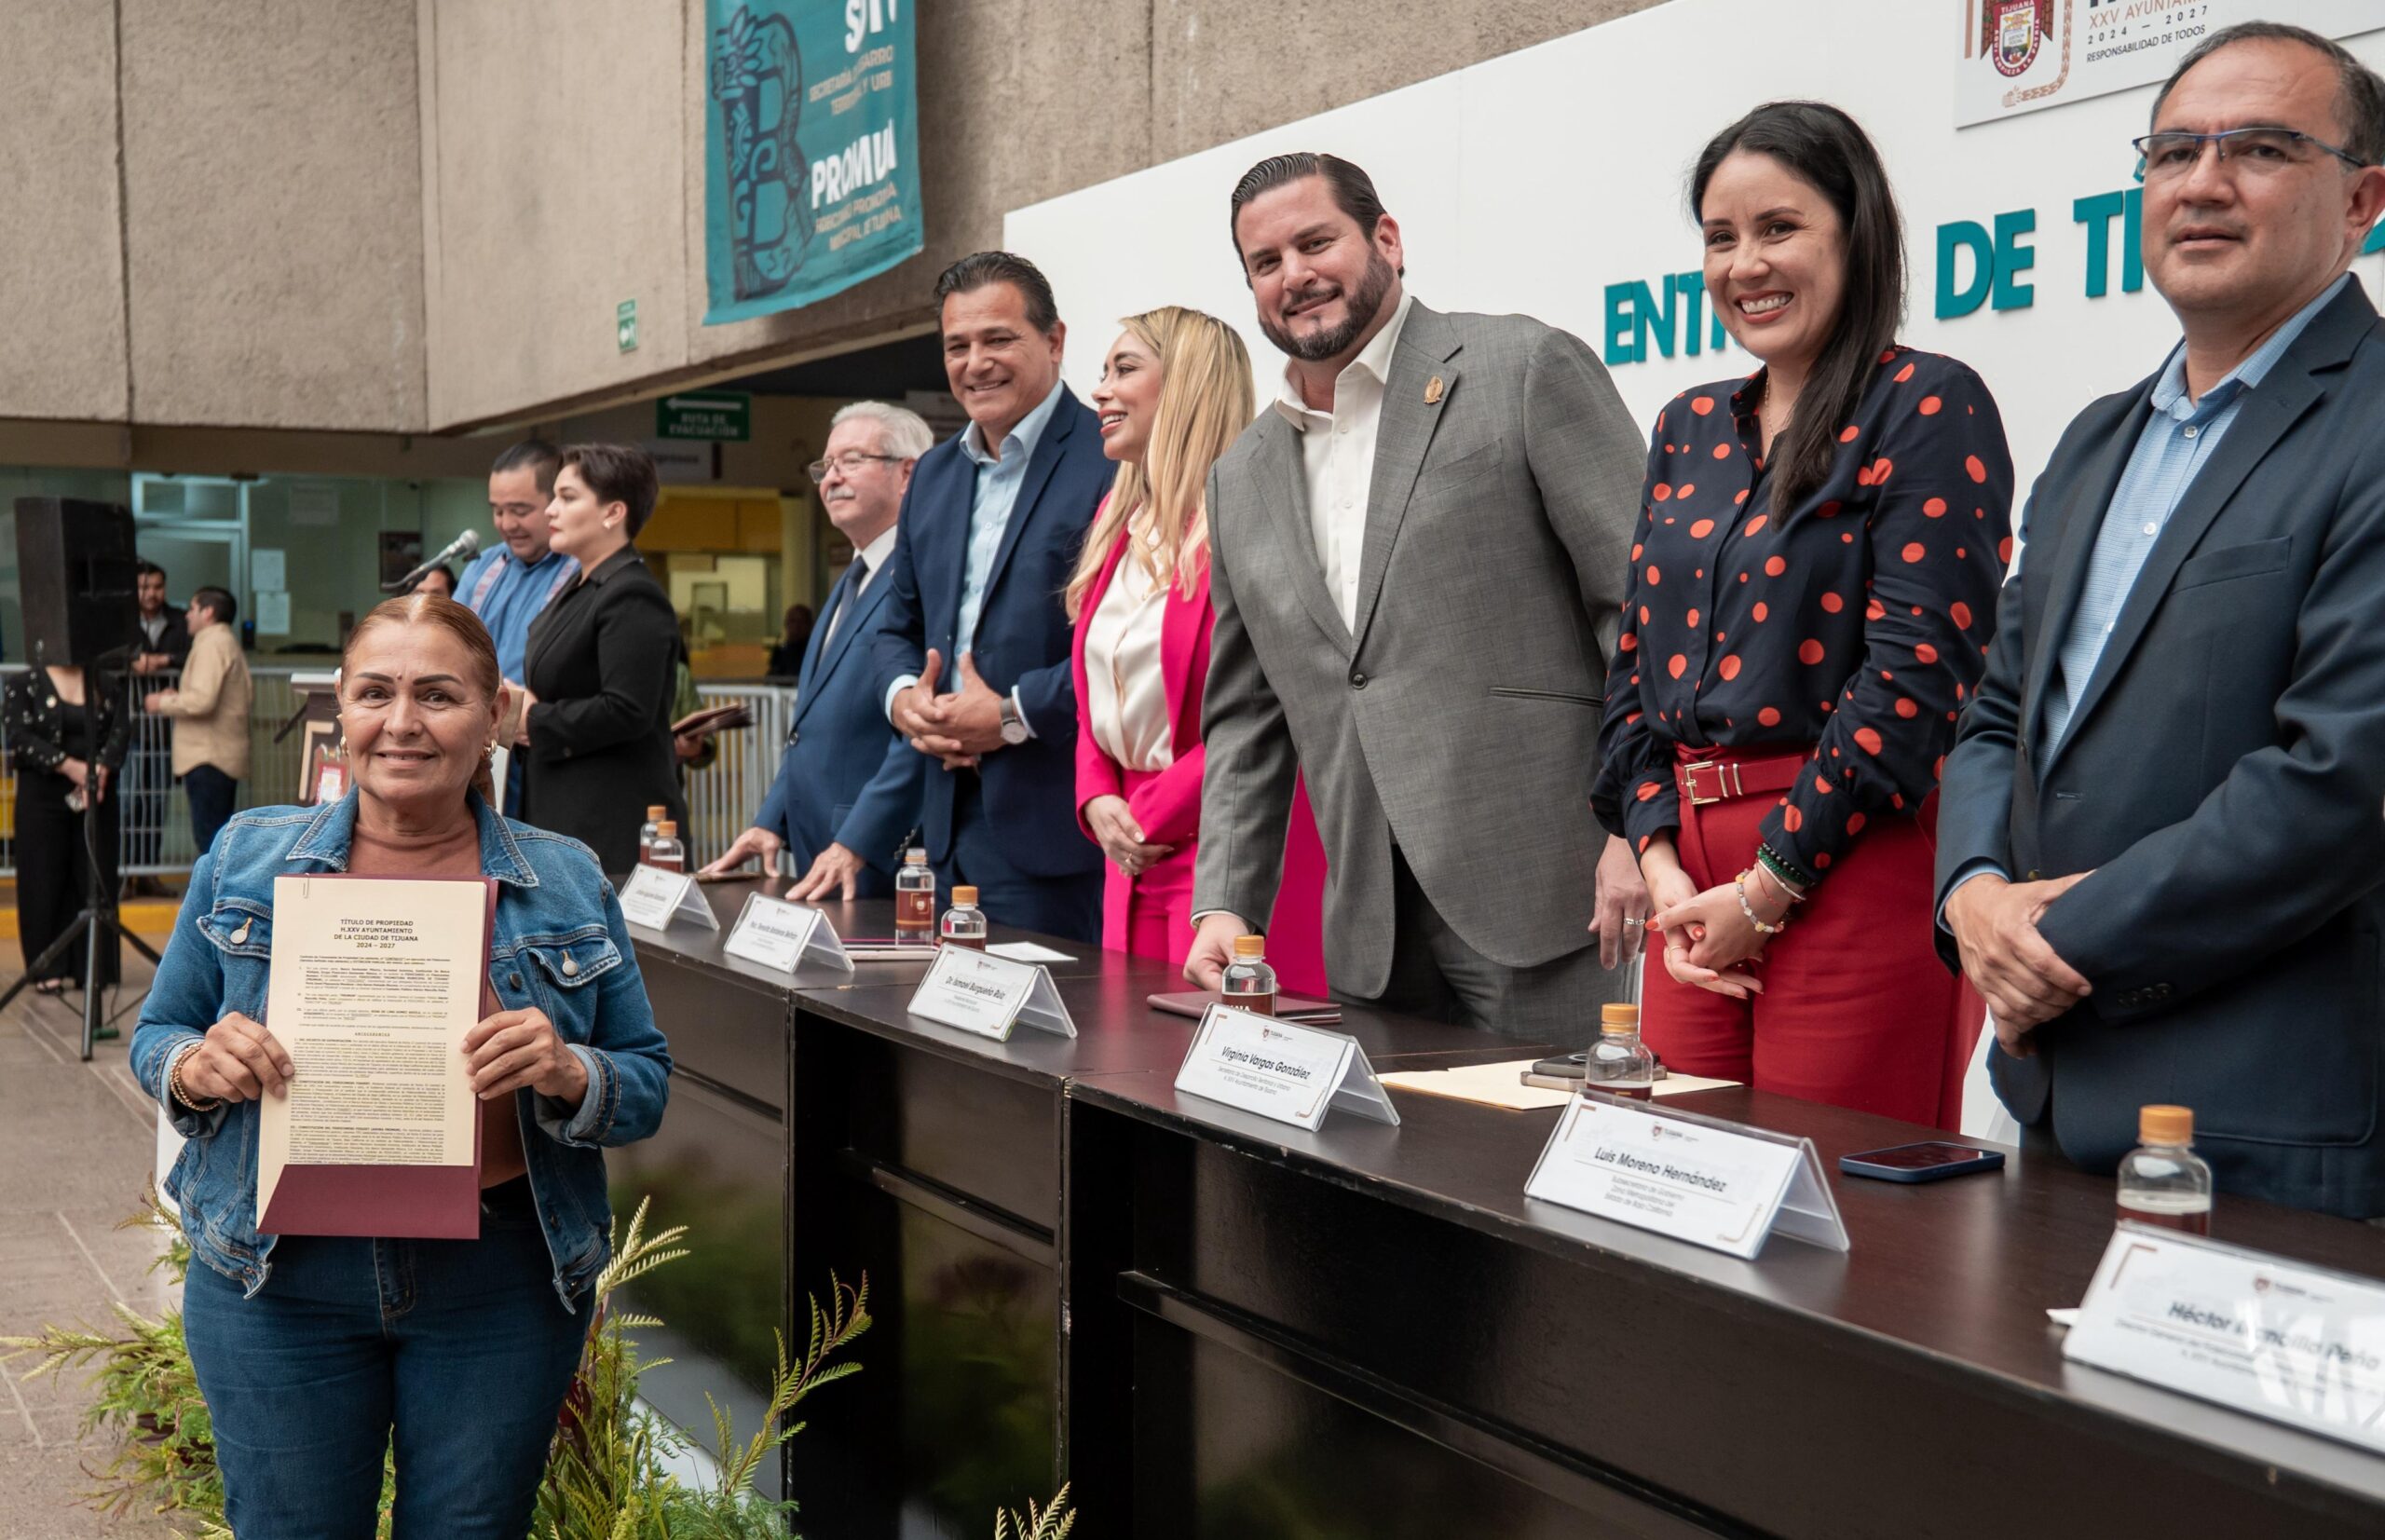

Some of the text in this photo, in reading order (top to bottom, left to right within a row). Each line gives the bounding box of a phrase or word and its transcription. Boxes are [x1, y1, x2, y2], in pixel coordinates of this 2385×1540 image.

[2001, 0, 2035, 14] TIJUANA
[2089, 7, 2120, 30] XXV
[2088, 26, 2127, 45] 2024
[2165, 5, 2207, 24] 2027
[2087, 24, 2205, 62] RESPONSABILIDAD DE TODOS
[1604, 270, 1738, 365] ENT
[1935, 208, 2036, 320] DE
[712, 414, 726, 425] DE
[1221, 1045, 1311, 1080] Virginia Vargas González
[1595, 1147, 1727, 1192] Luis Moreno Hernández
[2169, 1302, 2232, 1331] Héctor
